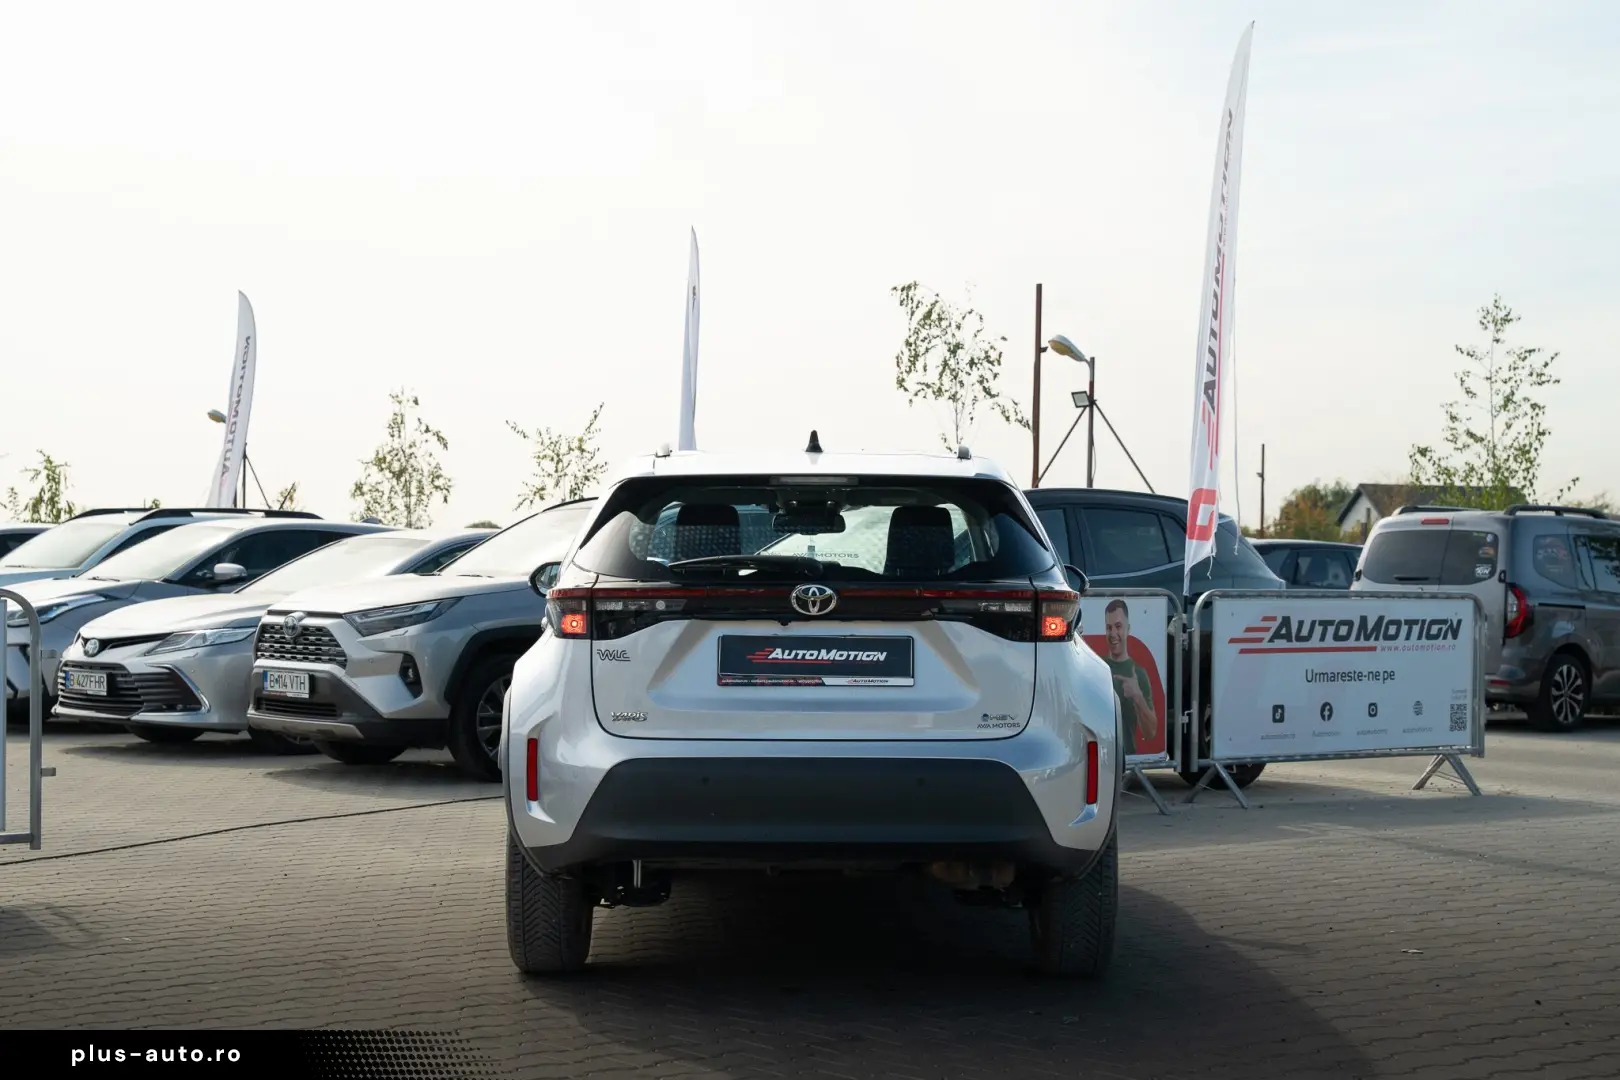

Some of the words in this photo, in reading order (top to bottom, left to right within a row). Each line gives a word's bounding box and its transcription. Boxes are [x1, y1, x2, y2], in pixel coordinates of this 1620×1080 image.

[1267, 615, 1463, 643] AUTOMOTION
[768, 648, 887, 661] AUTOMOTION
[1305, 668, 1381, 684] Urmareste-ne
[1382, 669, 1396, 684] pe
